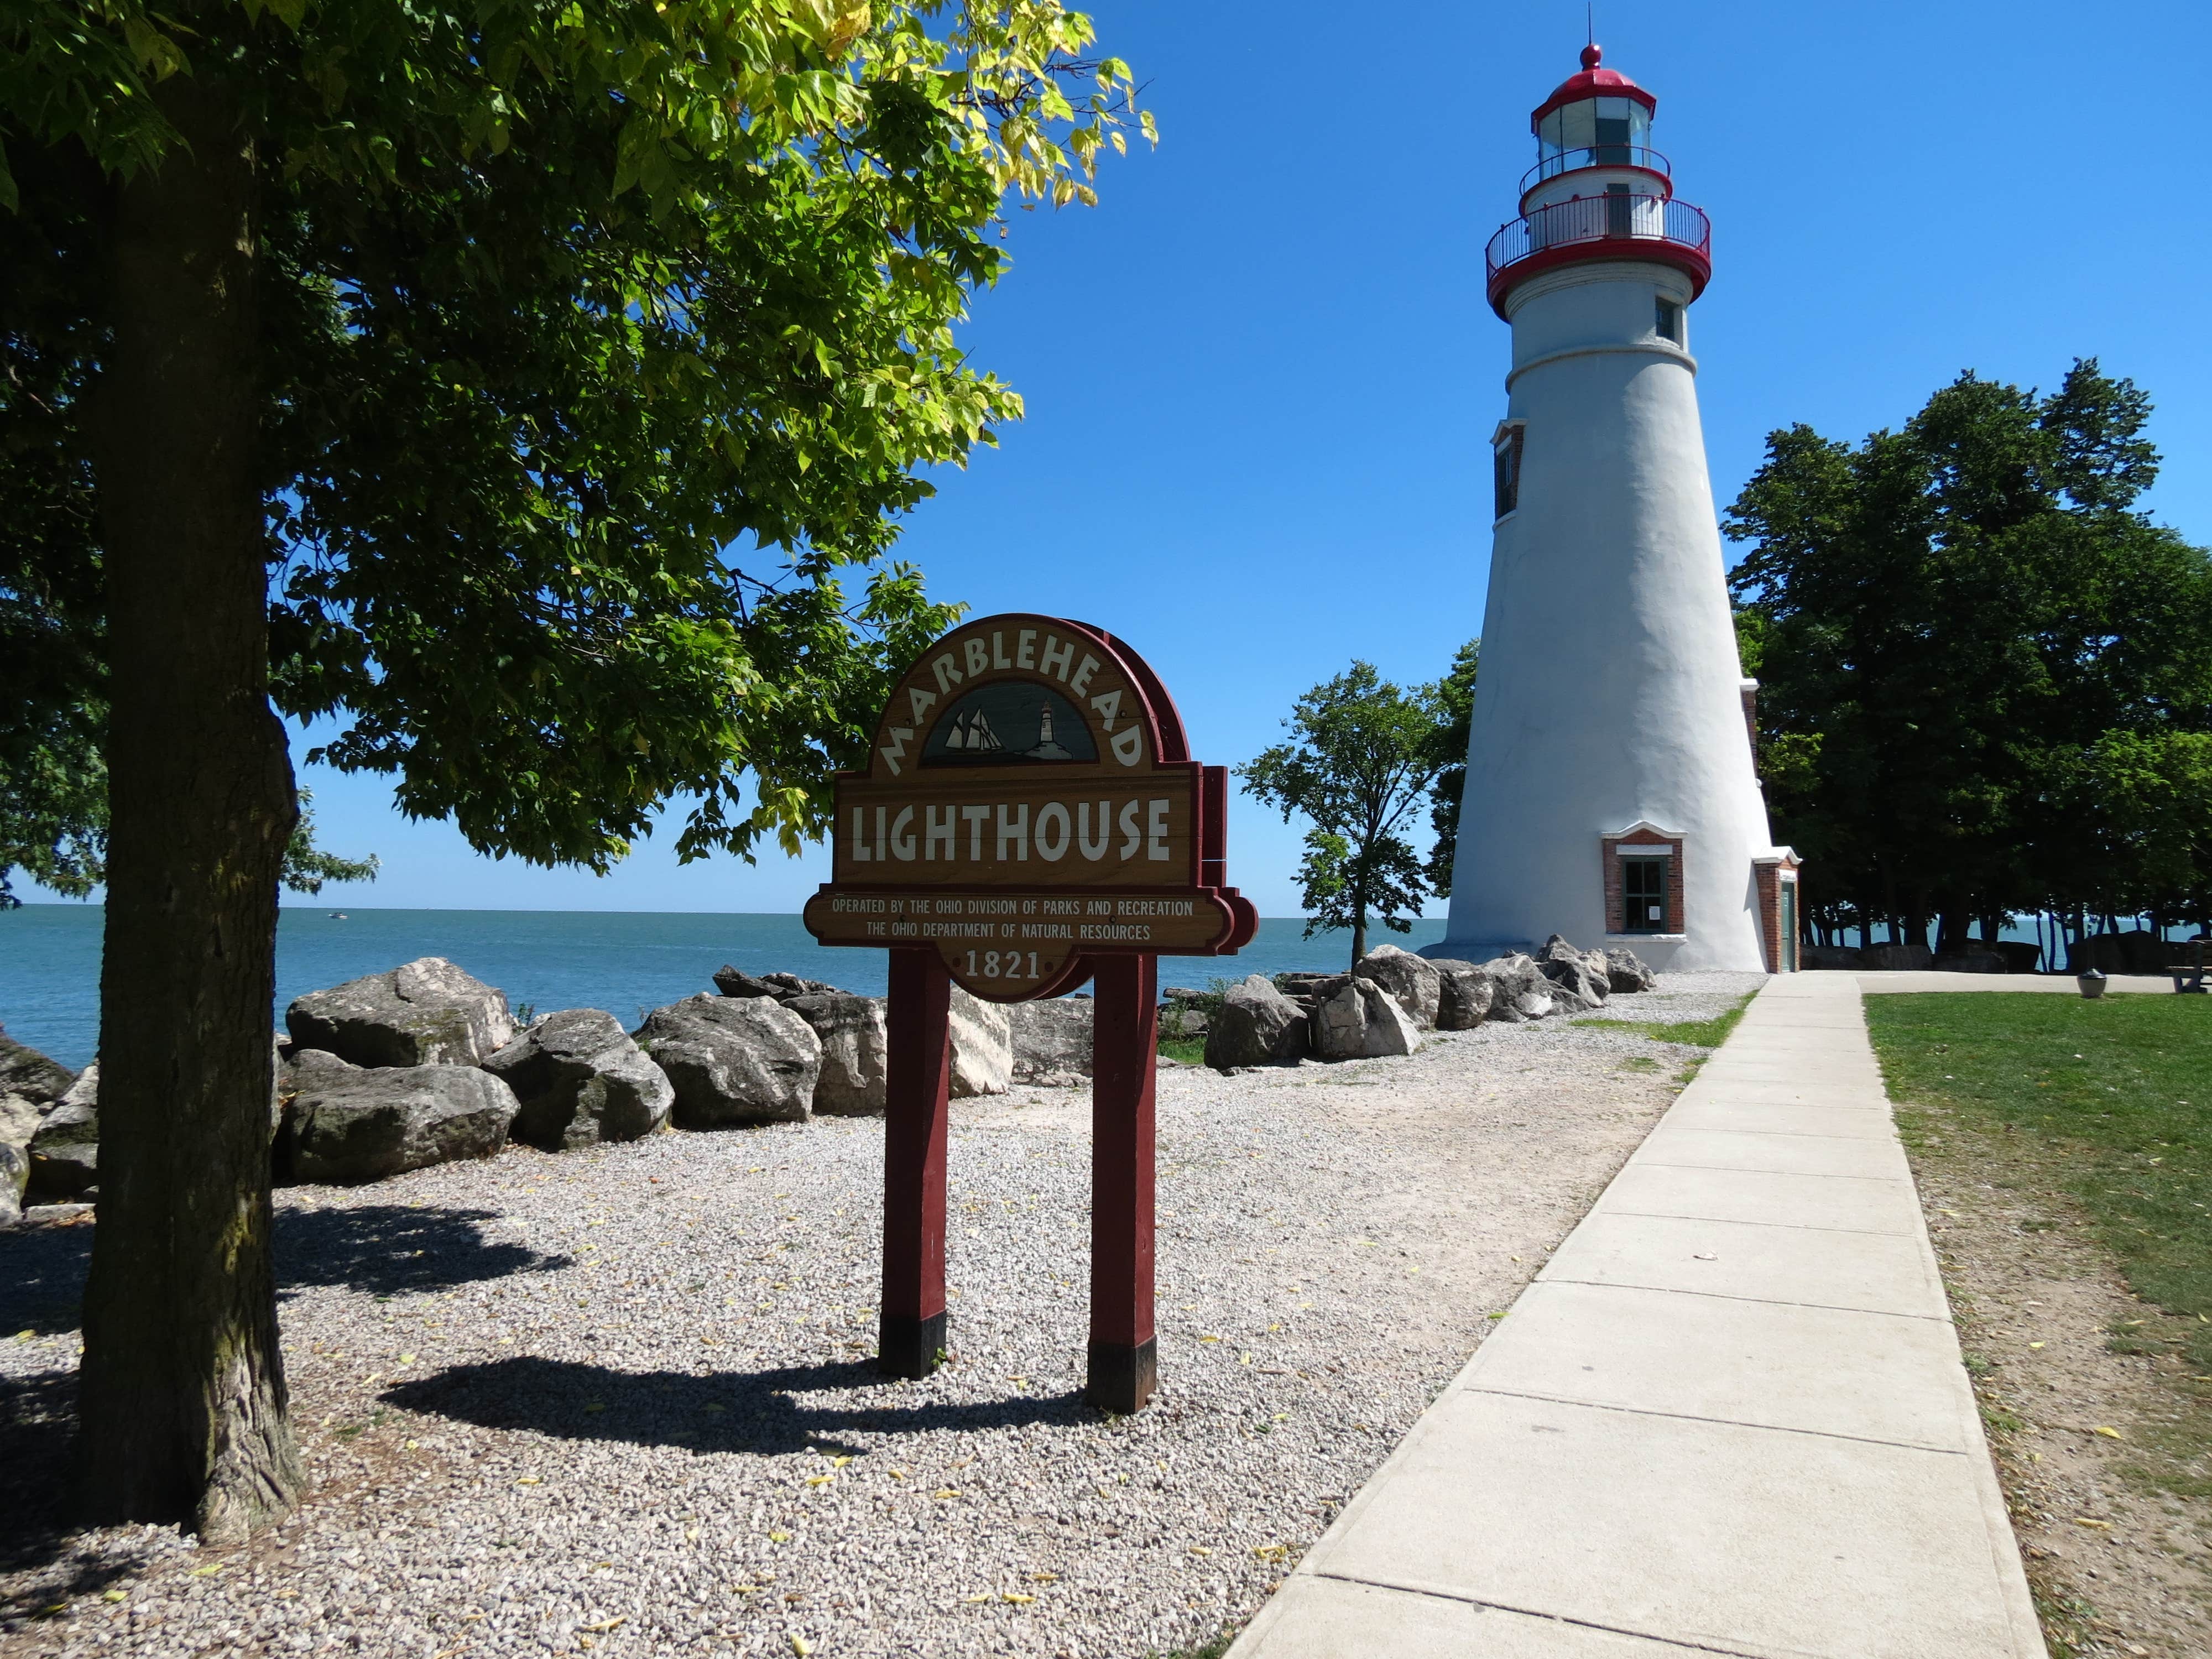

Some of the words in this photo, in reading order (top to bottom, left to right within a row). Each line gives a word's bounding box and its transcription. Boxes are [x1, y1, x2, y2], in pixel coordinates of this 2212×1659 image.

[879, 629, 1142, 776] MARBLEHEAD
[852, 799, 1170, 862] LIGHTHOUSE
[832, 898, 885, 912] OPERATED
[891, 899, 904, 913] BY
[910, 900, 930, 914] THE
[936, 900, 962, 914] OHIO
[968, 900, 1017, 914] DIVISION
[1023, 900, 1037, 915] OF
[1044, 900, 1080, 915] PARKS
[1087, 901, 1111, 915] AND
[1118, 901, 1193, 916] RECREATION
[867, 921, 885, 935] THE
[891, 922, 917, 936] OHIO
[923, 922, 995, 937] DEPARTMENT
[1001, 924, 1015, 937] OF
[1022, 924, 1073, 938] NATURAL
[1080, 925, 1151, 940] RESOURCES
[966, 950, 1039, 979] 1821
